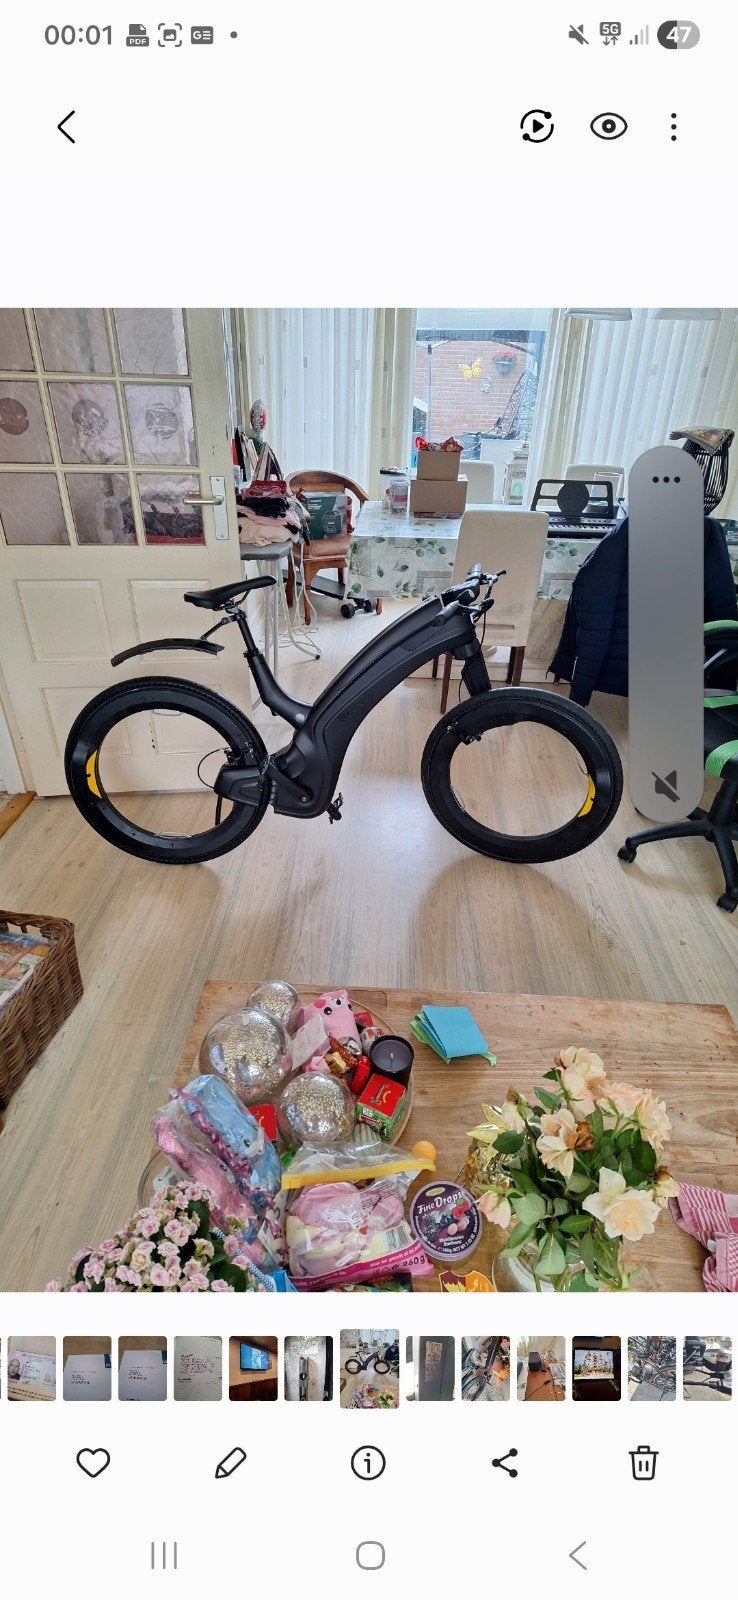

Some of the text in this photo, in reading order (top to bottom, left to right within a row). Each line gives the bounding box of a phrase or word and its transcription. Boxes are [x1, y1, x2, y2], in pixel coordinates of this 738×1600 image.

[44, 24, 112, 46] 00:01
[602, 23, 619, 35] 5G
[666, 26, 692, 43] 47
[417, 1201, 435, 1214] Fine
[434, 1191, 463, 1208] Drops
